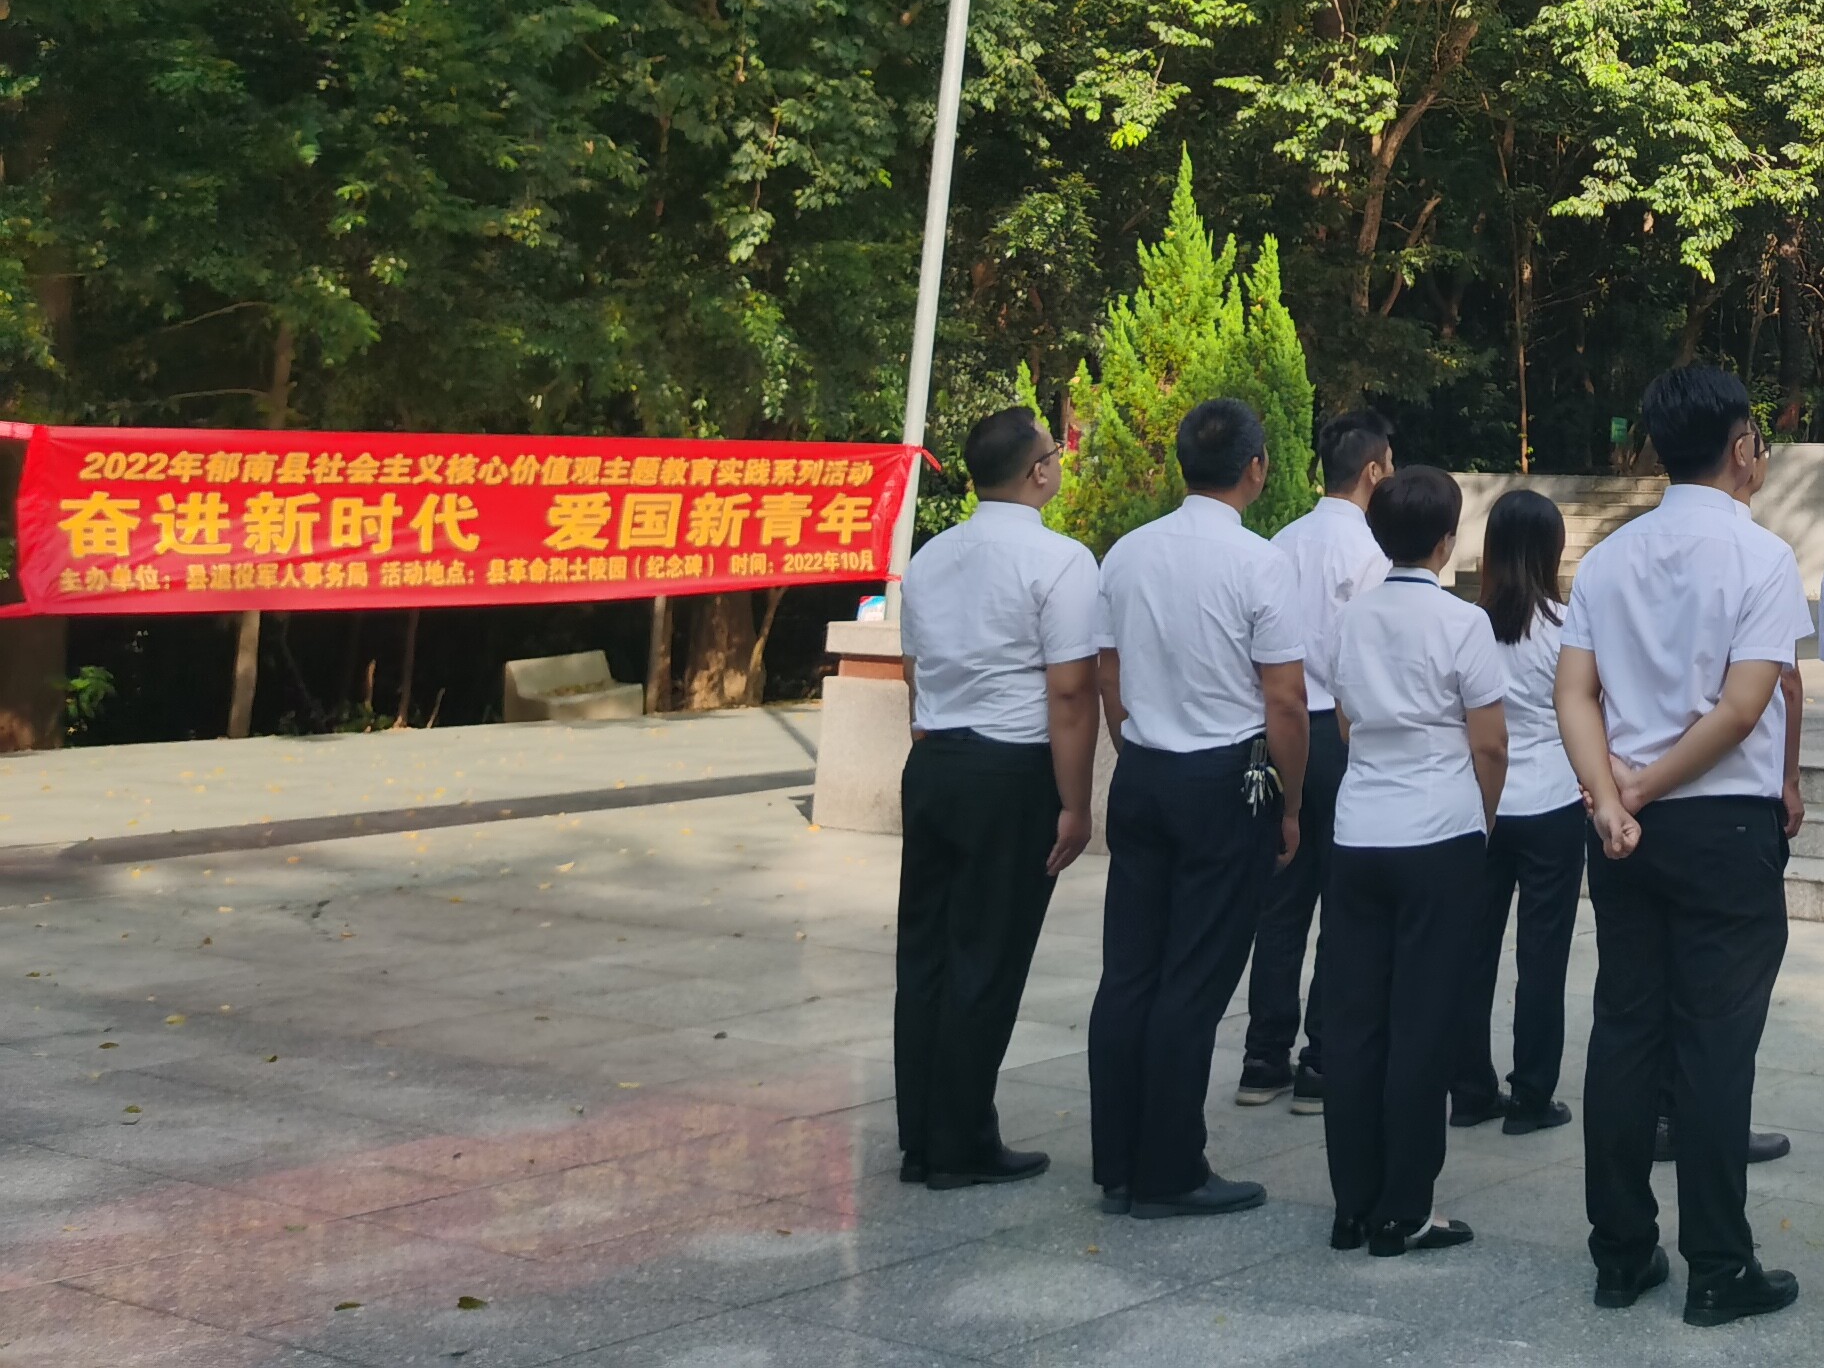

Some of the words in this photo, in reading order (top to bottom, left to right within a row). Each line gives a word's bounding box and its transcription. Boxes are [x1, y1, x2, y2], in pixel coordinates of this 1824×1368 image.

[79, 450, 873, 489] 2022年郁南县社会主义核心价值观主题教育实践系列活动
[58, 490, 480, 558] 奋进新时代
[545, 490, 874, 552] 爱国新青年
